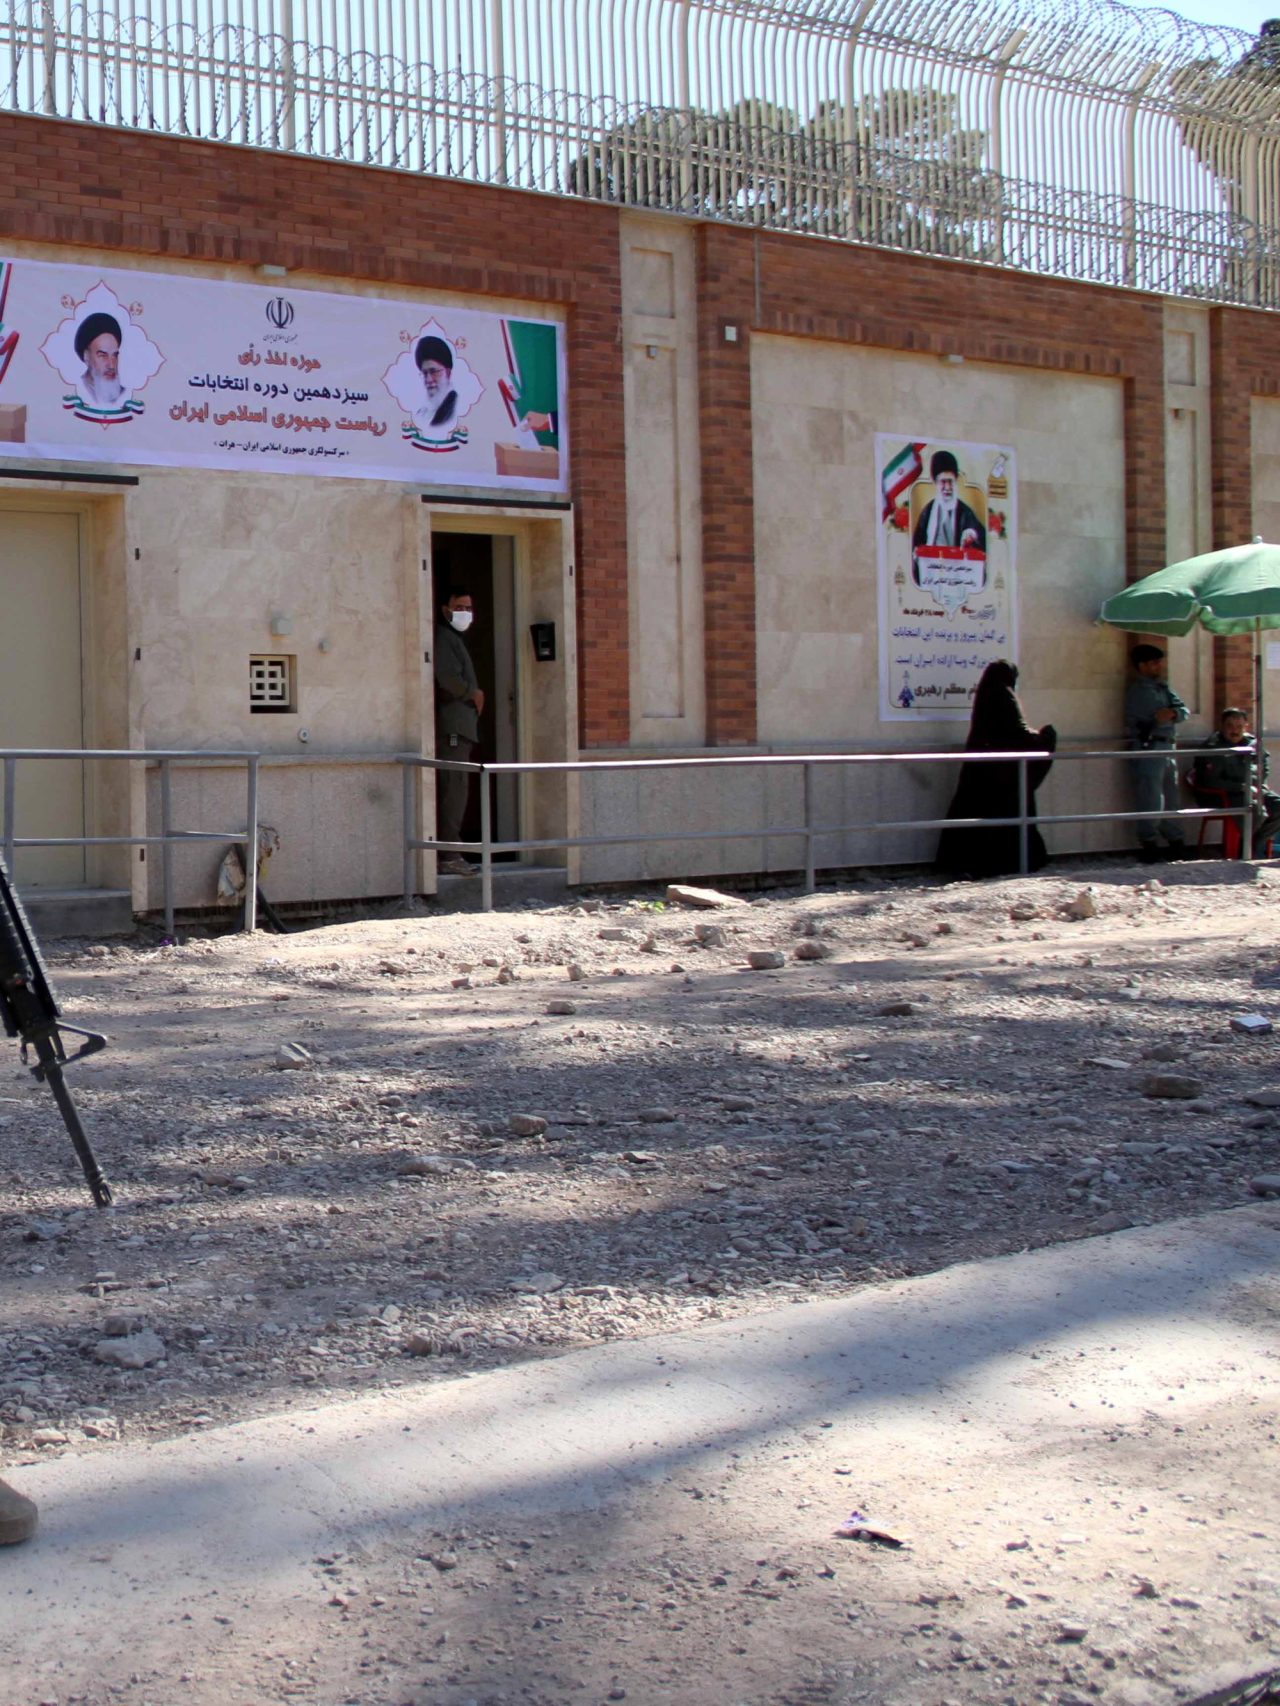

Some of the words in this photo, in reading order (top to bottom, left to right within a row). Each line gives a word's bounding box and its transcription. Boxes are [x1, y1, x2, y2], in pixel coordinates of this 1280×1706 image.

[264, 349, 288, 366] اخذ
[290, 353, 322, 374] حوزه
[188, 373, 249, 393] انتخابات
[253, 382, 289, 399] دوره
[293, 386, 369, 405] سیزدهمین
[168, 400, 209, 422] ایران
[213, 405, 268, 426] اسلامی
[271, 413, 331, 433] جمهوری
[335, 415, 387, 437] ریاست
[259, 442, 282, 453] اسلامی
[282, 446, 307, 455] جمهوری
